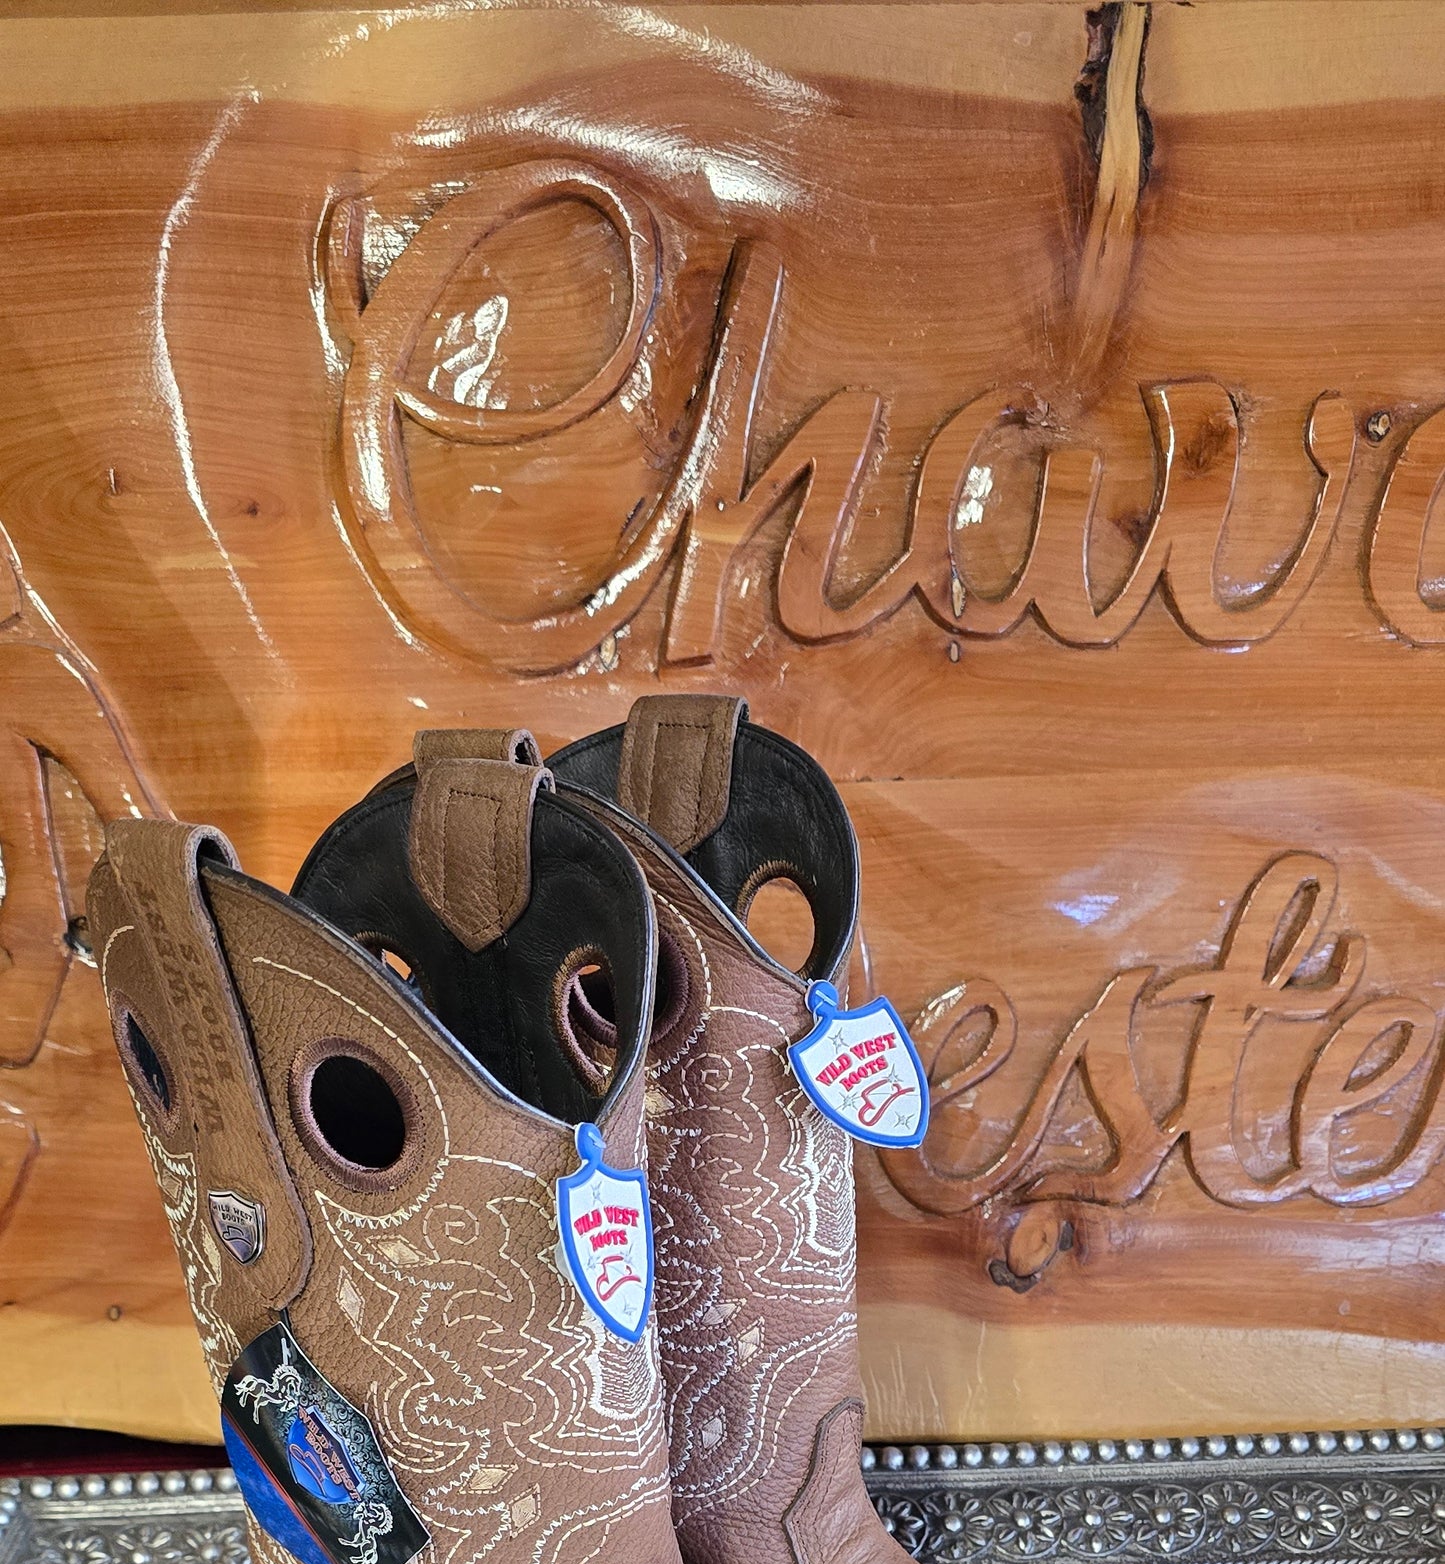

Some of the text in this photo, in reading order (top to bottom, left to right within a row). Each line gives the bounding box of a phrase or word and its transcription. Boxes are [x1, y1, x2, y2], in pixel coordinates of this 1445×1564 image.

[133, 882, 224, 1136] WILD WEST
[178, 942, 236, 1092] BOOTS
[816, 1031, 897, 1087] WILD WEST
[839, 1055, 889, 1092] BOOTS
[213, 1204, 253, 1222] WILD WEST
[222, 1213, 245, 1225] BOOTS
[573, 1204, 640, 1235] WILD WEST
[589, 1229, 628, 1252] BOOTS
[298, 1404, 362, 1501] WILD WEST
[305, 1432, 343, 1486] BOOTS
